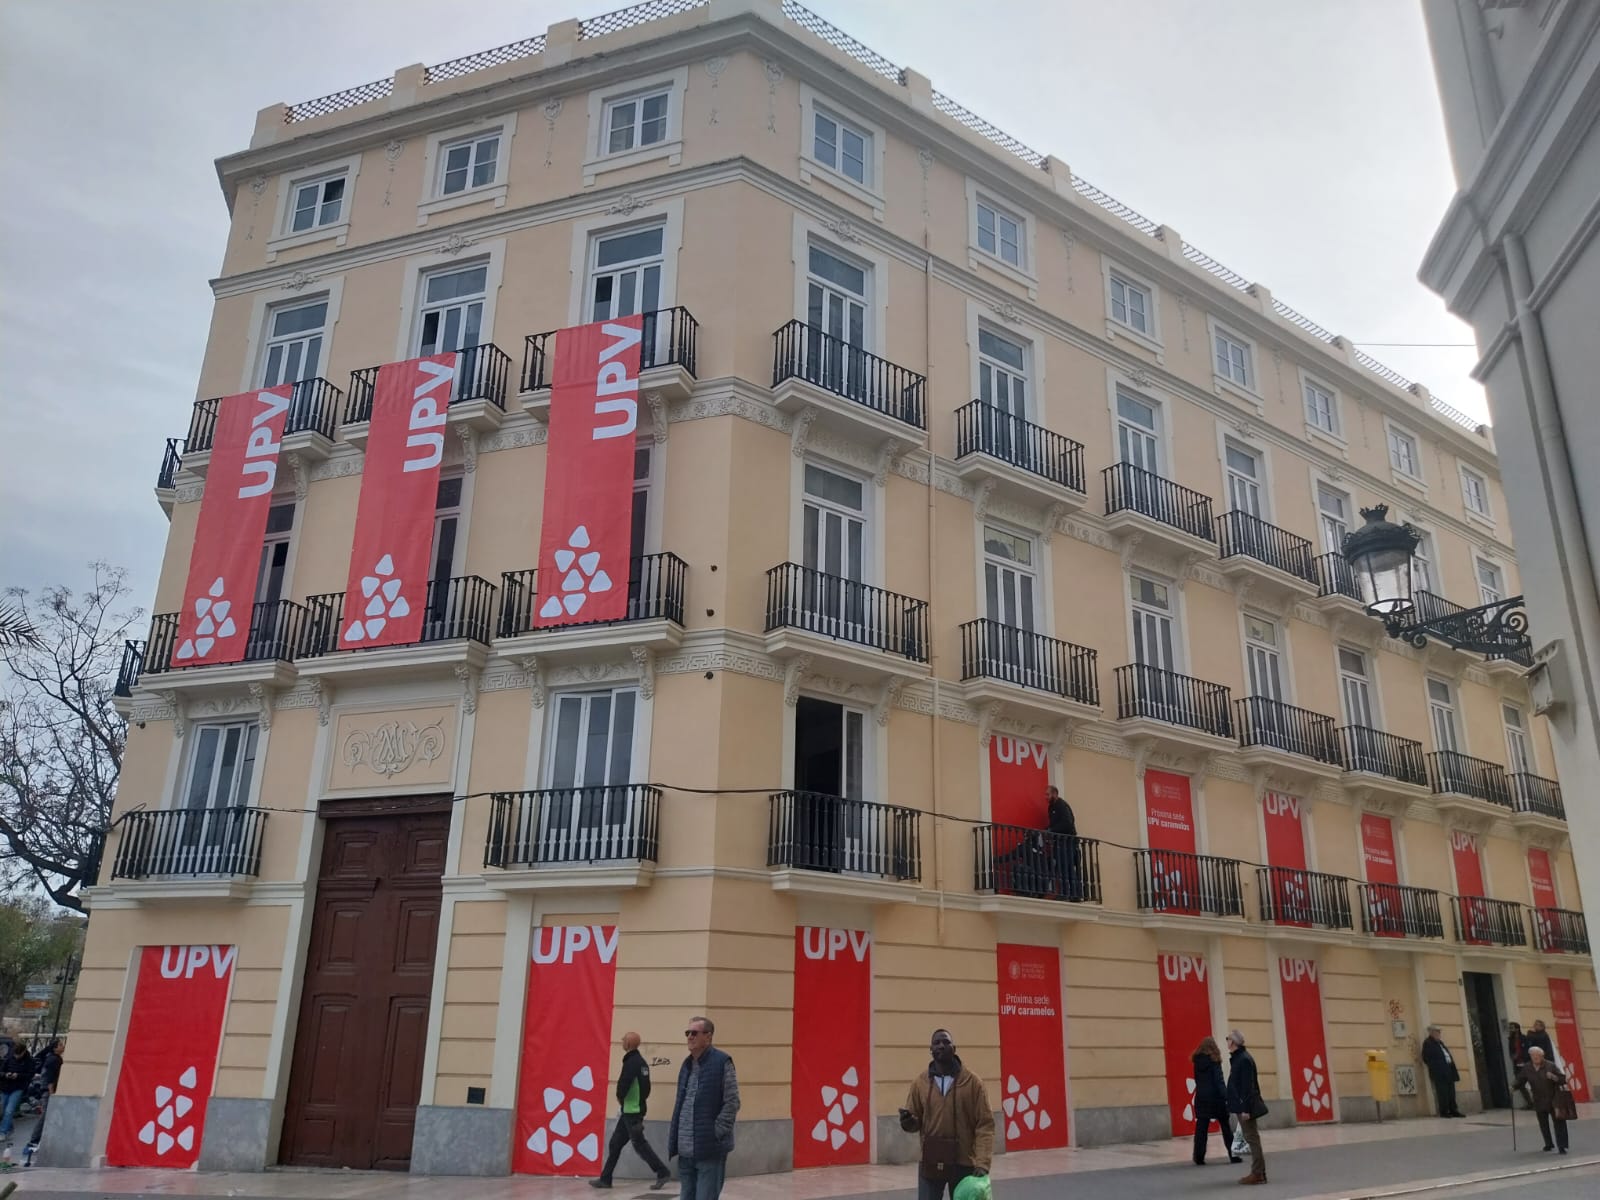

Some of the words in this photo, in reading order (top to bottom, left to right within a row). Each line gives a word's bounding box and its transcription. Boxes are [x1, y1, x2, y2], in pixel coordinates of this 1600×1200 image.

[592, 323, 642, 440] UPV
[403, 361, 454, 472] UPV
[238, 391, 290, 499] UPV
[996, 735, 1049, 769] UPV
[1265, 791, 1300, 820] UPV
[1451, 831, 1478, 854] UPV
[532, 925, 619, 964] UPV
[803, 926, 872, 962] UPV
[161, 945, 238, 979] UPV
[1163, 953, 1208, 983] UPV
[1281, 957, 1318, 984] UPV
[1001, 1005, 1017, 1015] UPV
[1018, 1006, 1056, 1017] caramelos
